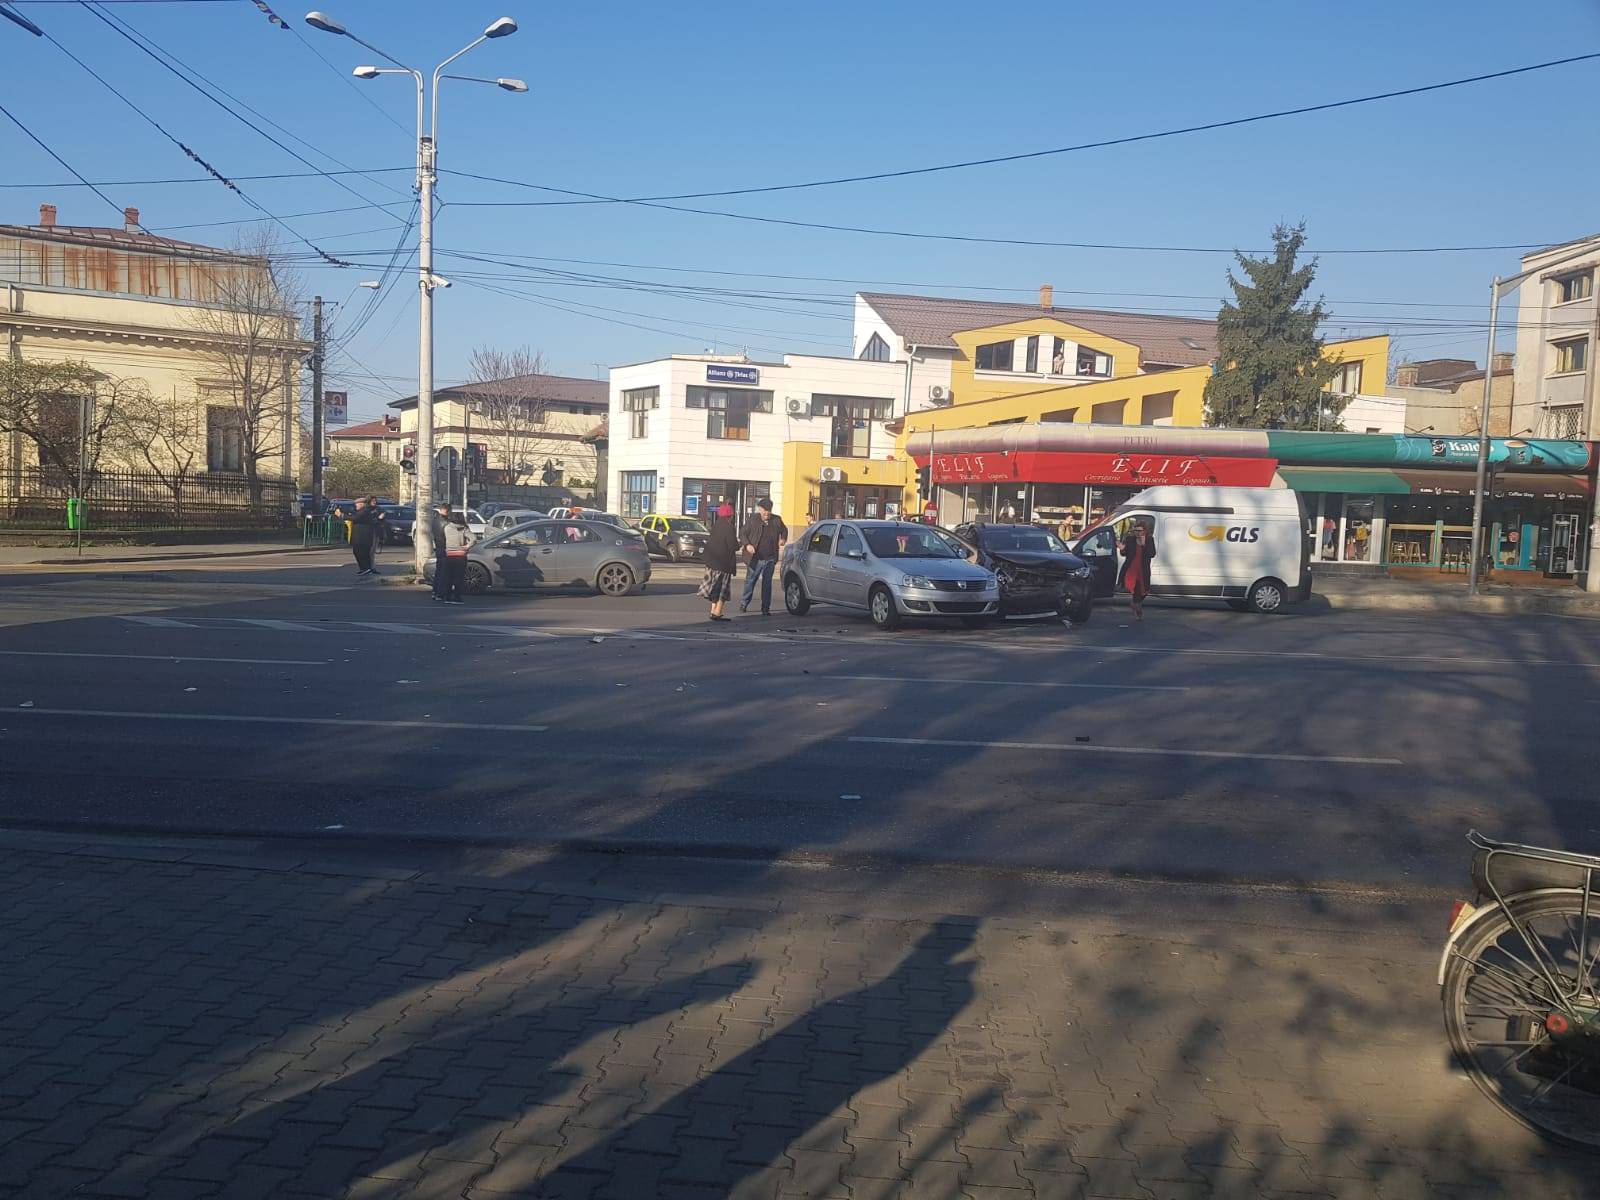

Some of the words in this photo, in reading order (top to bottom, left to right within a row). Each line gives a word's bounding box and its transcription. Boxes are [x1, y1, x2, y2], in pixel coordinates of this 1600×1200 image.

[937, 456, 985, 473] ELIF
[1111, 458, 1199, 477] ELIF
[1226, 526, 1260, 543] GLS
